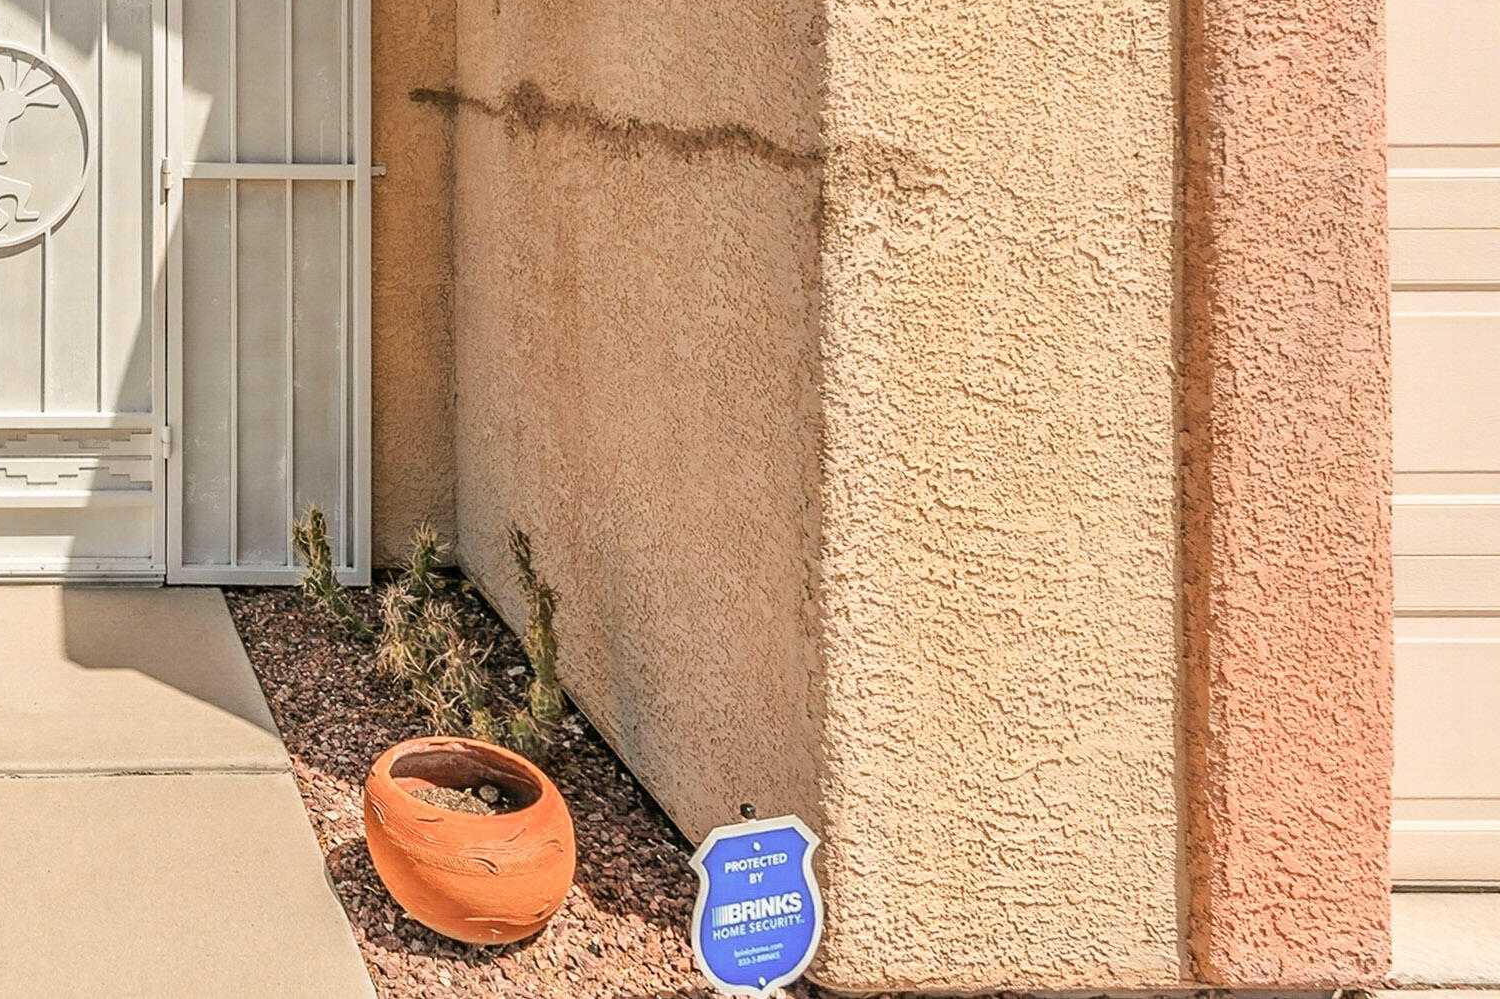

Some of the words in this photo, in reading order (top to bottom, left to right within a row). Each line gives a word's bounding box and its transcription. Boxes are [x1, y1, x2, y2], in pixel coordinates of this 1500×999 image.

[725, 853, 788, 874] PROTECTED
[749, 872, 764, 884] BY
[728, 892, 802, 925] BRINKS
[712, 924, 747, 940] HOME
[748, 914, 801, 933] SECURITY
